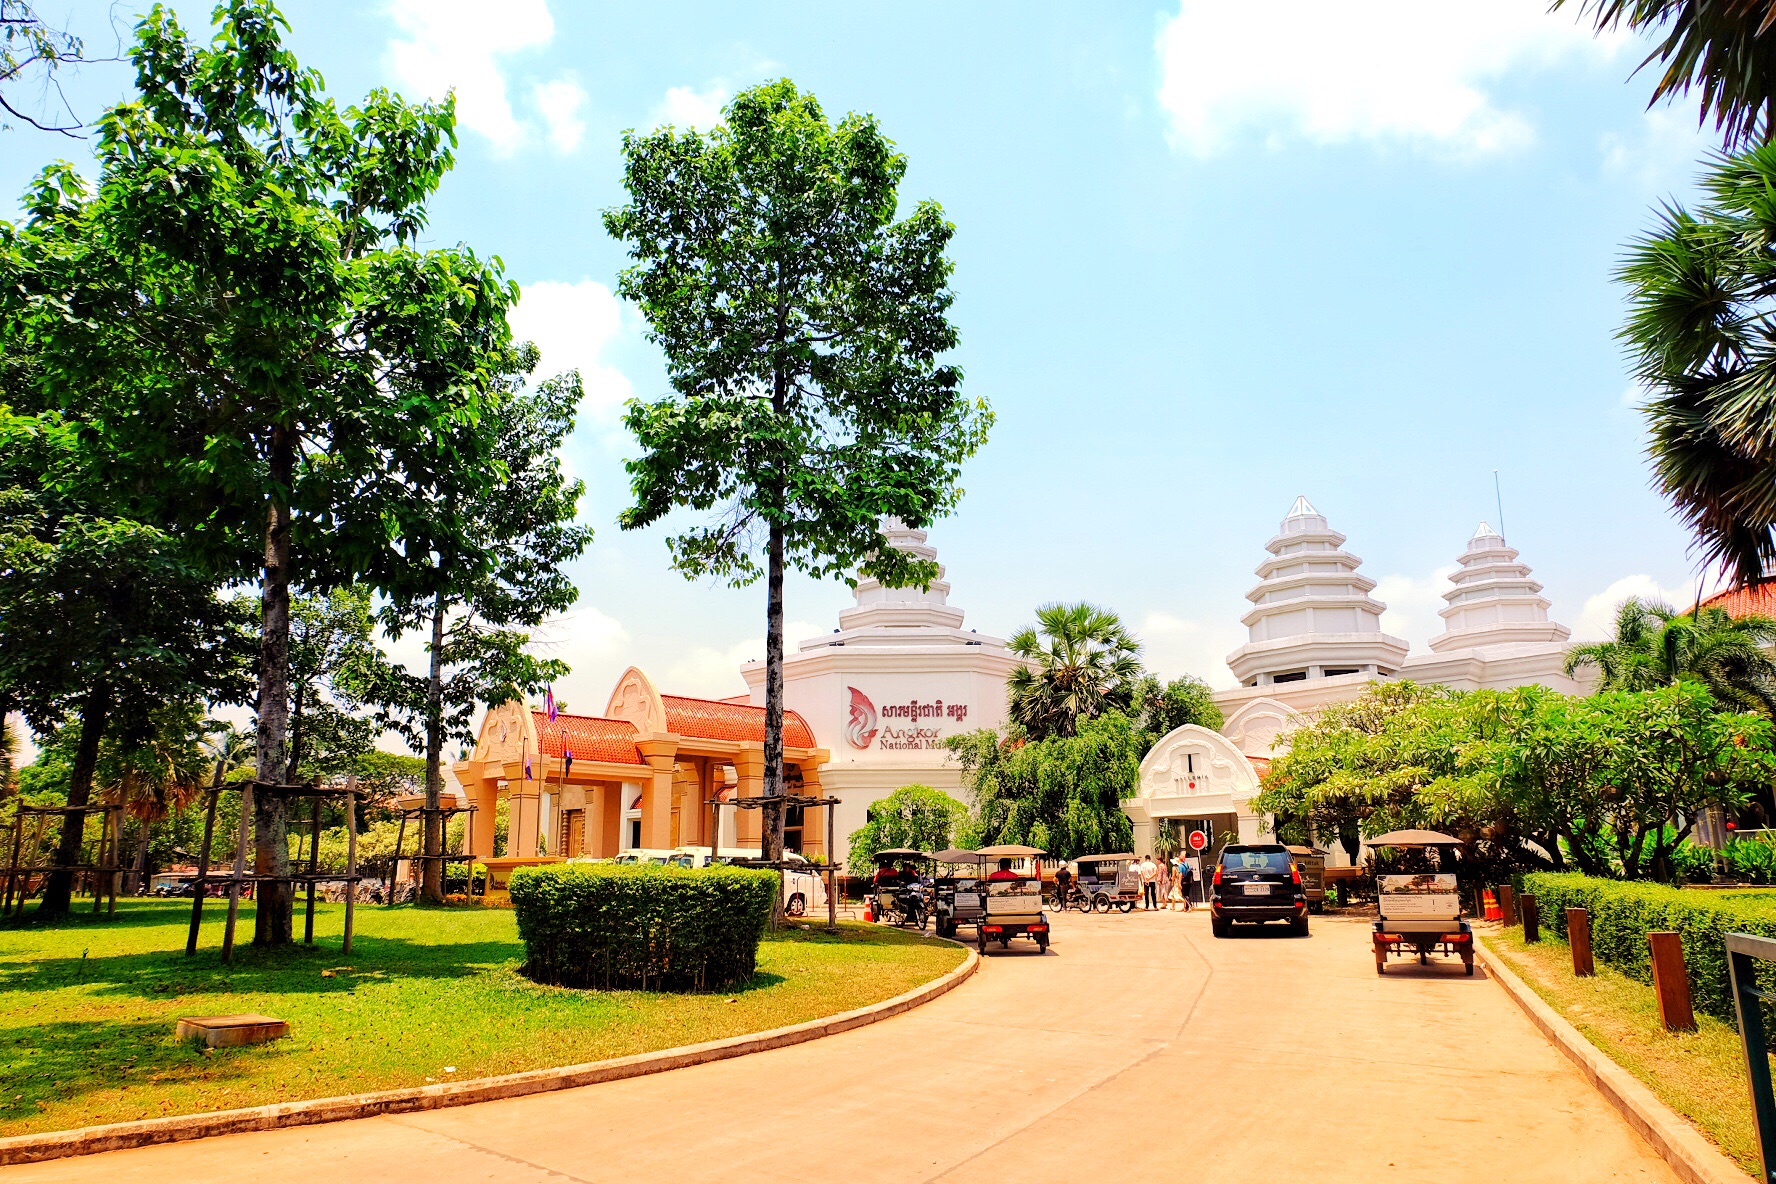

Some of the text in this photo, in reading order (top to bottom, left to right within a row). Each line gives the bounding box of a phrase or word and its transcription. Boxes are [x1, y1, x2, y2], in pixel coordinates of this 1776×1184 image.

[881, 724, 942, 742] Angkor
[880, 740, 950, 750] National Mus
